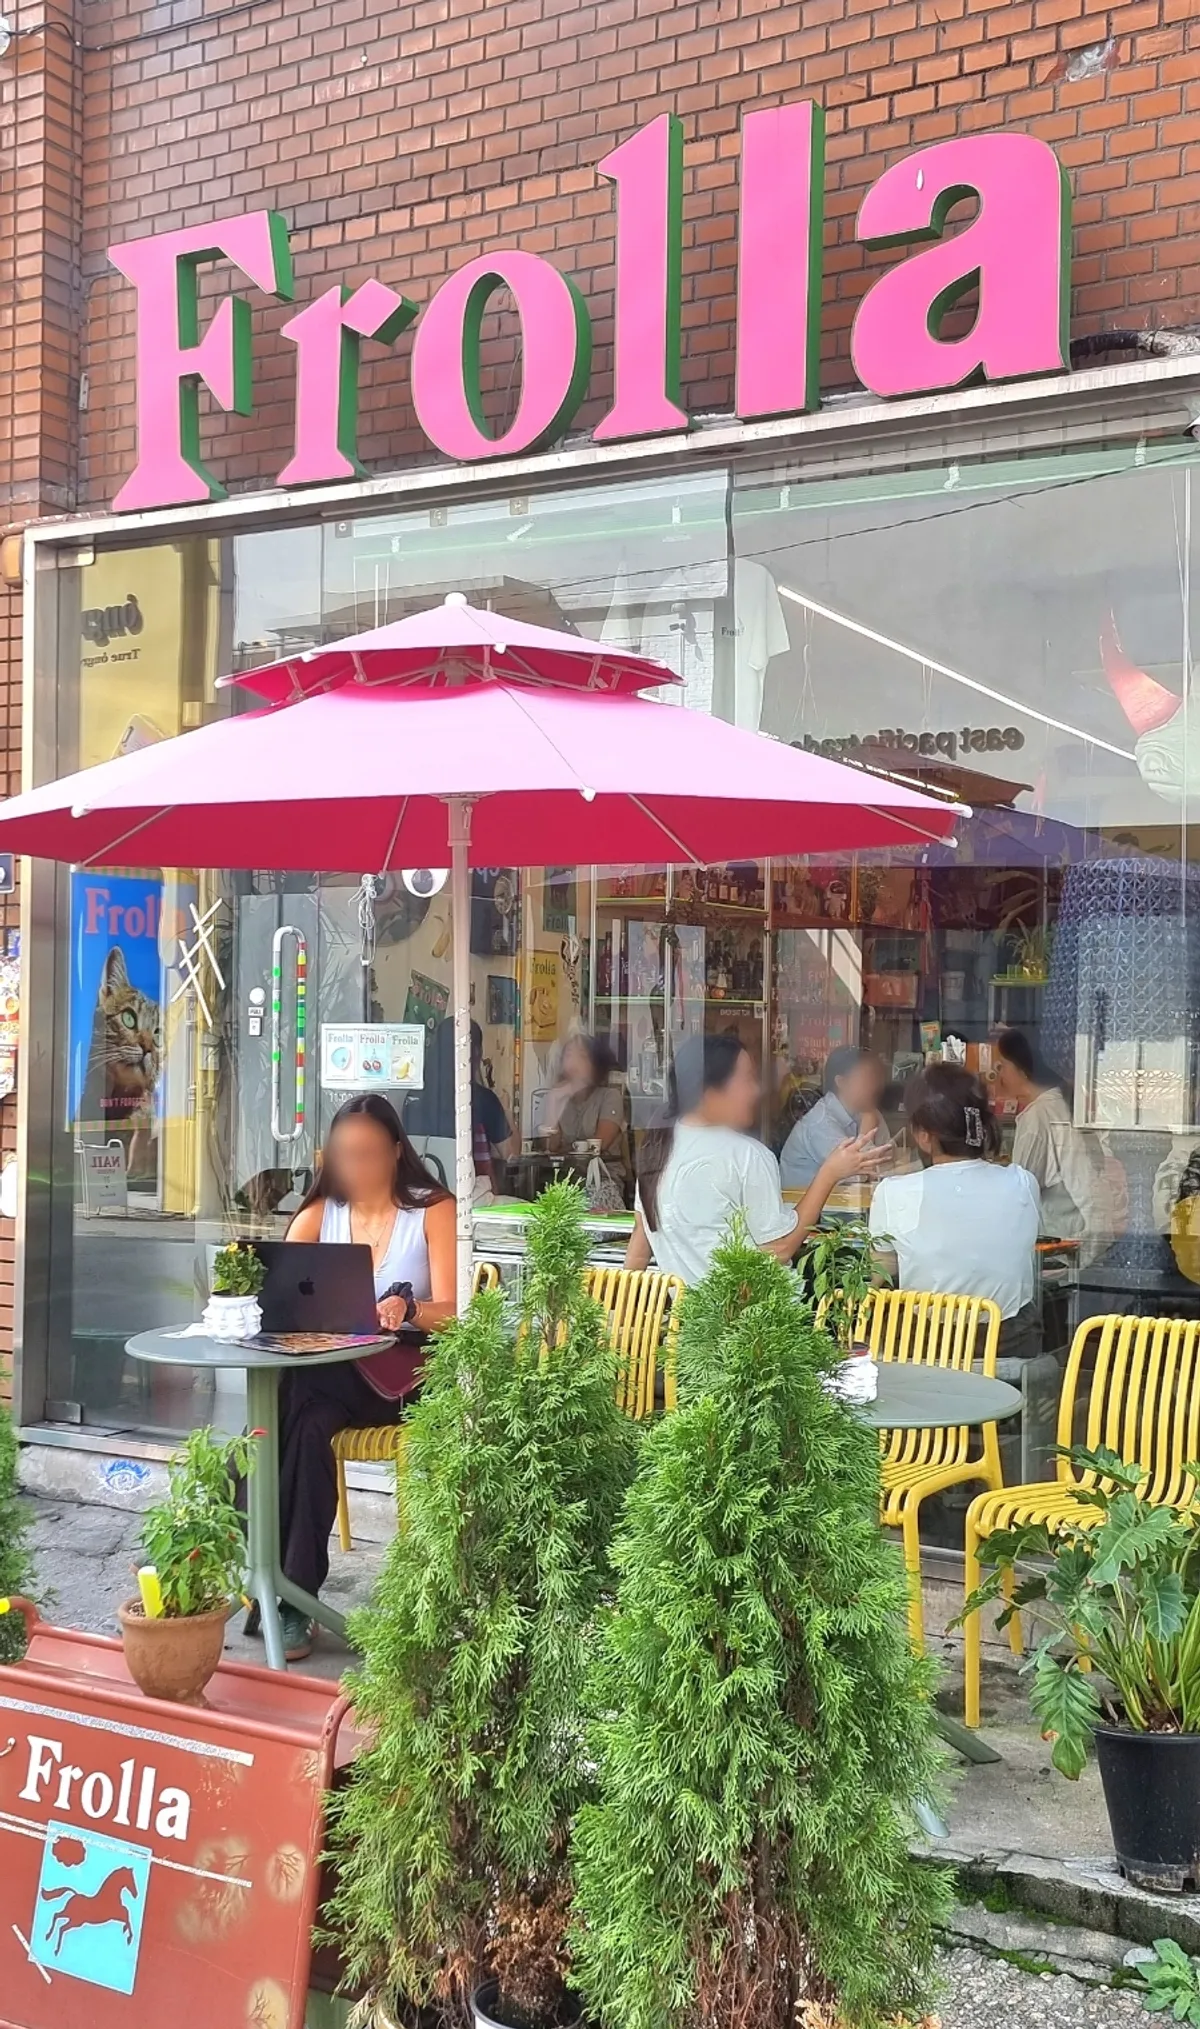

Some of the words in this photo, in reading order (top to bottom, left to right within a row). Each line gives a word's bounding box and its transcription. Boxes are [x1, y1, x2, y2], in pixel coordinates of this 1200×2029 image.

[107, 99, 1073, 512] Frolla
[360, 1033, 385, 1044] Frolla
[392, 1035, 418, 1046] Frolla
[18, 1735, 191, 1840] Frolla
